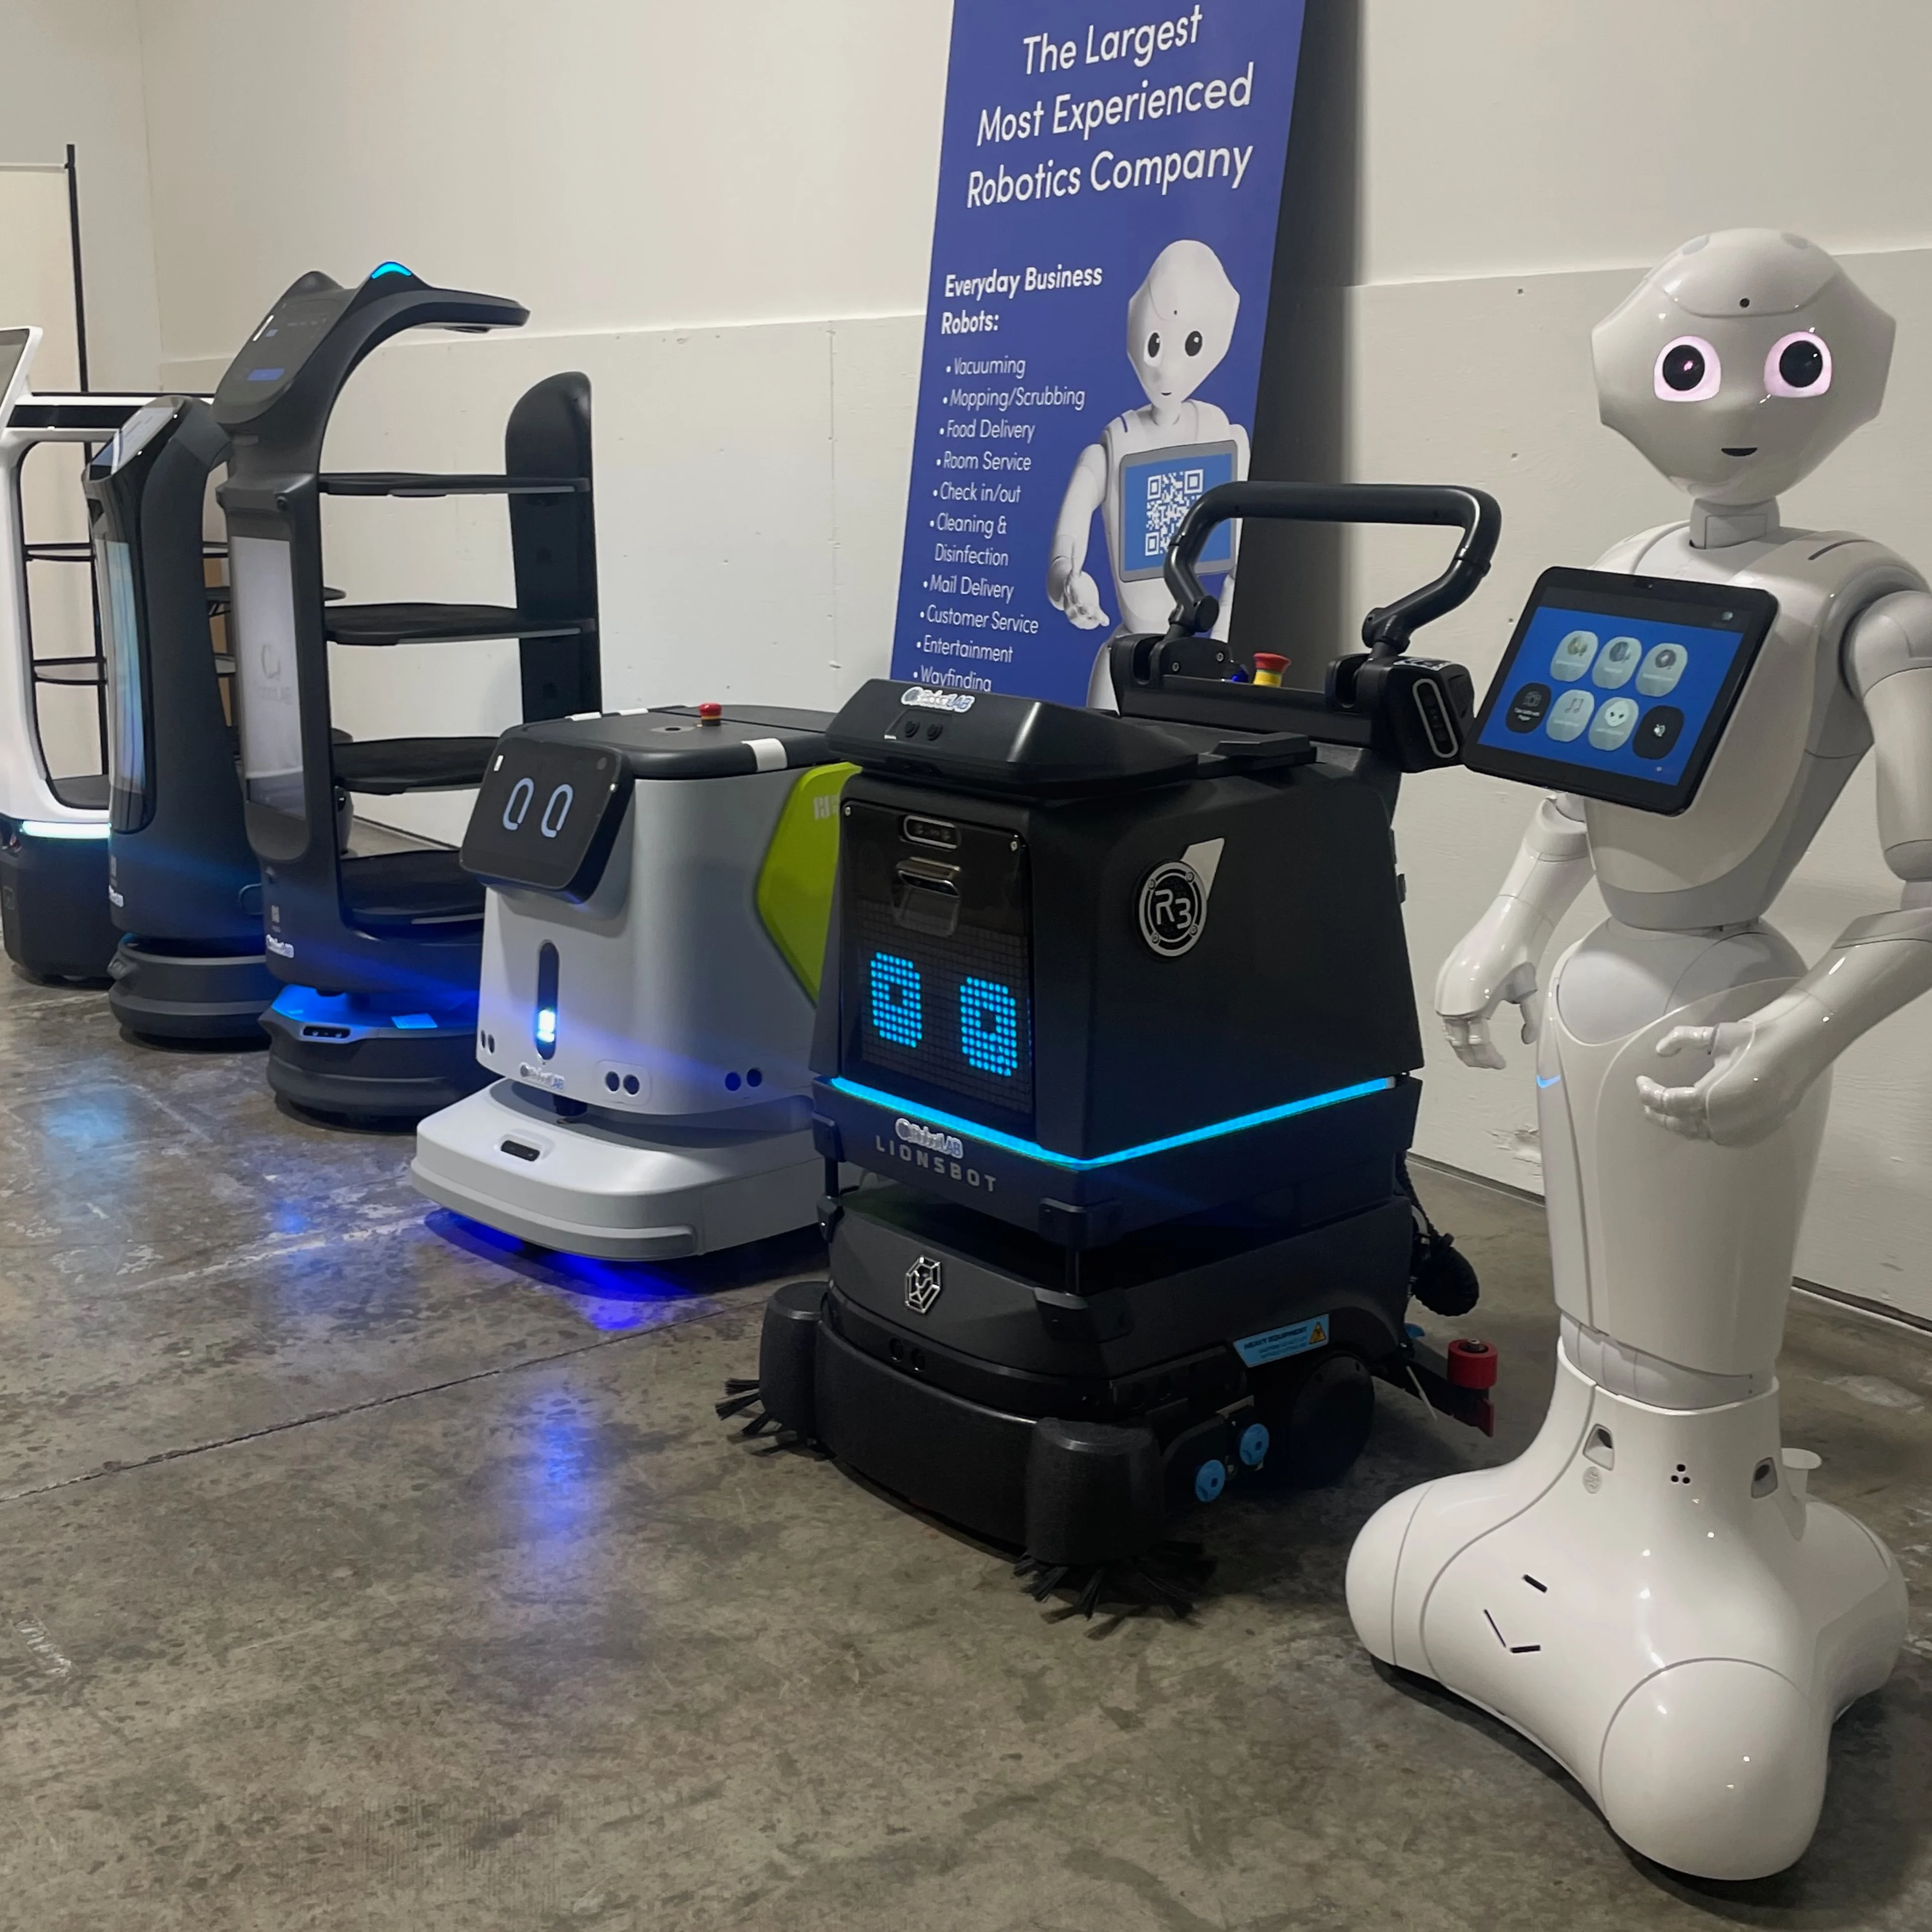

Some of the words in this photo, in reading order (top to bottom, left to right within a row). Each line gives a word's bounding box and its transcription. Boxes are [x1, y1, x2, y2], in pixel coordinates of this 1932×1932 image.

[1023, 33, 1076, 74] The
[1086, 5, 1202, 66] Largest
[977, 101, 1044, 146] Most
[1053, 62, 1253, 140] Experienced
[968, 160, 1081, 208] Robotics
[1091, 146, 1253, 195] Company
[945, 269, 1020, 301] Everyday
[1025, 264, 1102, 290] Business
[942, 310, 999, 334] Robots:
[955, 356, 1025, 379] Vacuuming
[950, 386, 1085, 411] Mopping/Scrubbing
[947, 419, 976, 437] Food
[980, 419, 1035, 443] Delivery
[944, 451, 978, 468] Room
[983, 451, 1031, 470] Service
[941, 482, 977, 500] Check
[981, 484, 1021, 502] in/out
[937, 513, 994, 538] Cleaning
[998, 516, 1006, 534] &
[935, 543, 1008, 566] Disinfection
[930, 575, 956, 593] Mail
[961, 577, 1014, 604] Delivery
[927, 604, 989, 627] Customer
[991, 611, 1038, 633] Service
[924, 635, 1013, 662] Entertainment
[1155, 889, 1192, 930] R3
[875, 1135, 996, 1192] LIONSBOT
